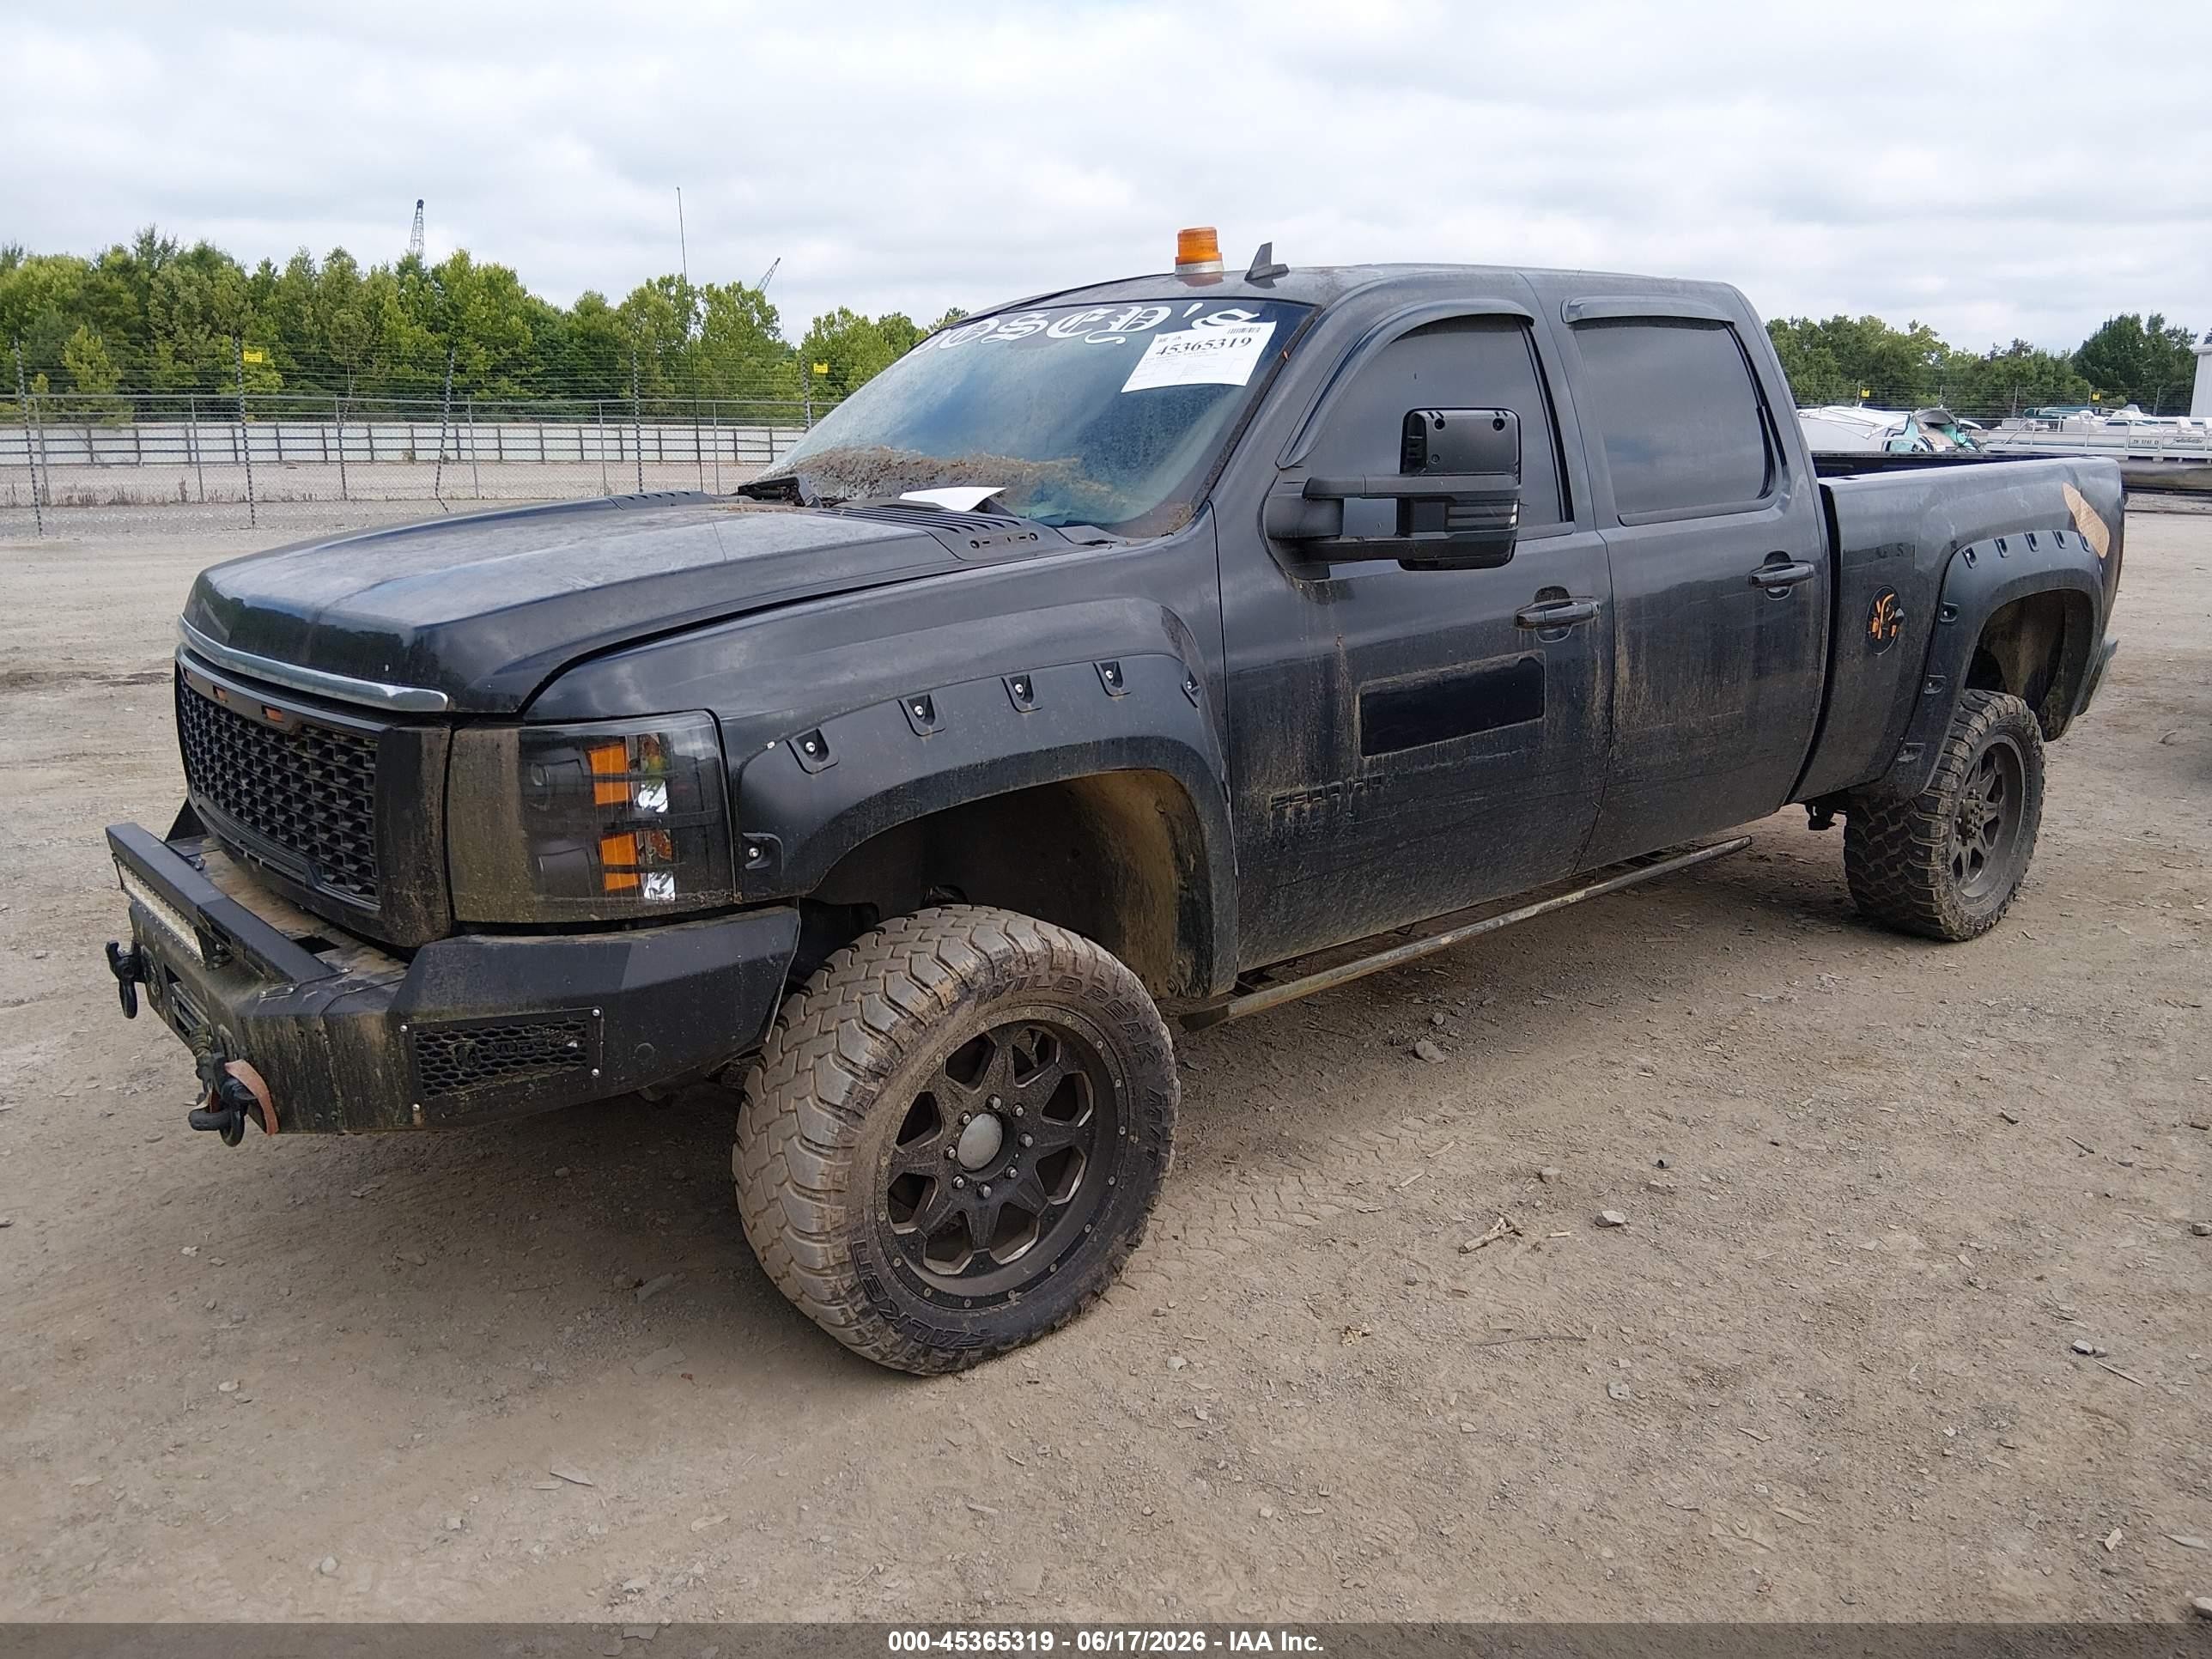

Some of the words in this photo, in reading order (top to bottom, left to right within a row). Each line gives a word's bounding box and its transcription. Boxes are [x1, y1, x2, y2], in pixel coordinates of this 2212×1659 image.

[1156, 337, 1252, 356] 45365319
[976, 975, 1156, 1066] WILDPEAK
[852, 1240, 988, 1349] FALKEN
